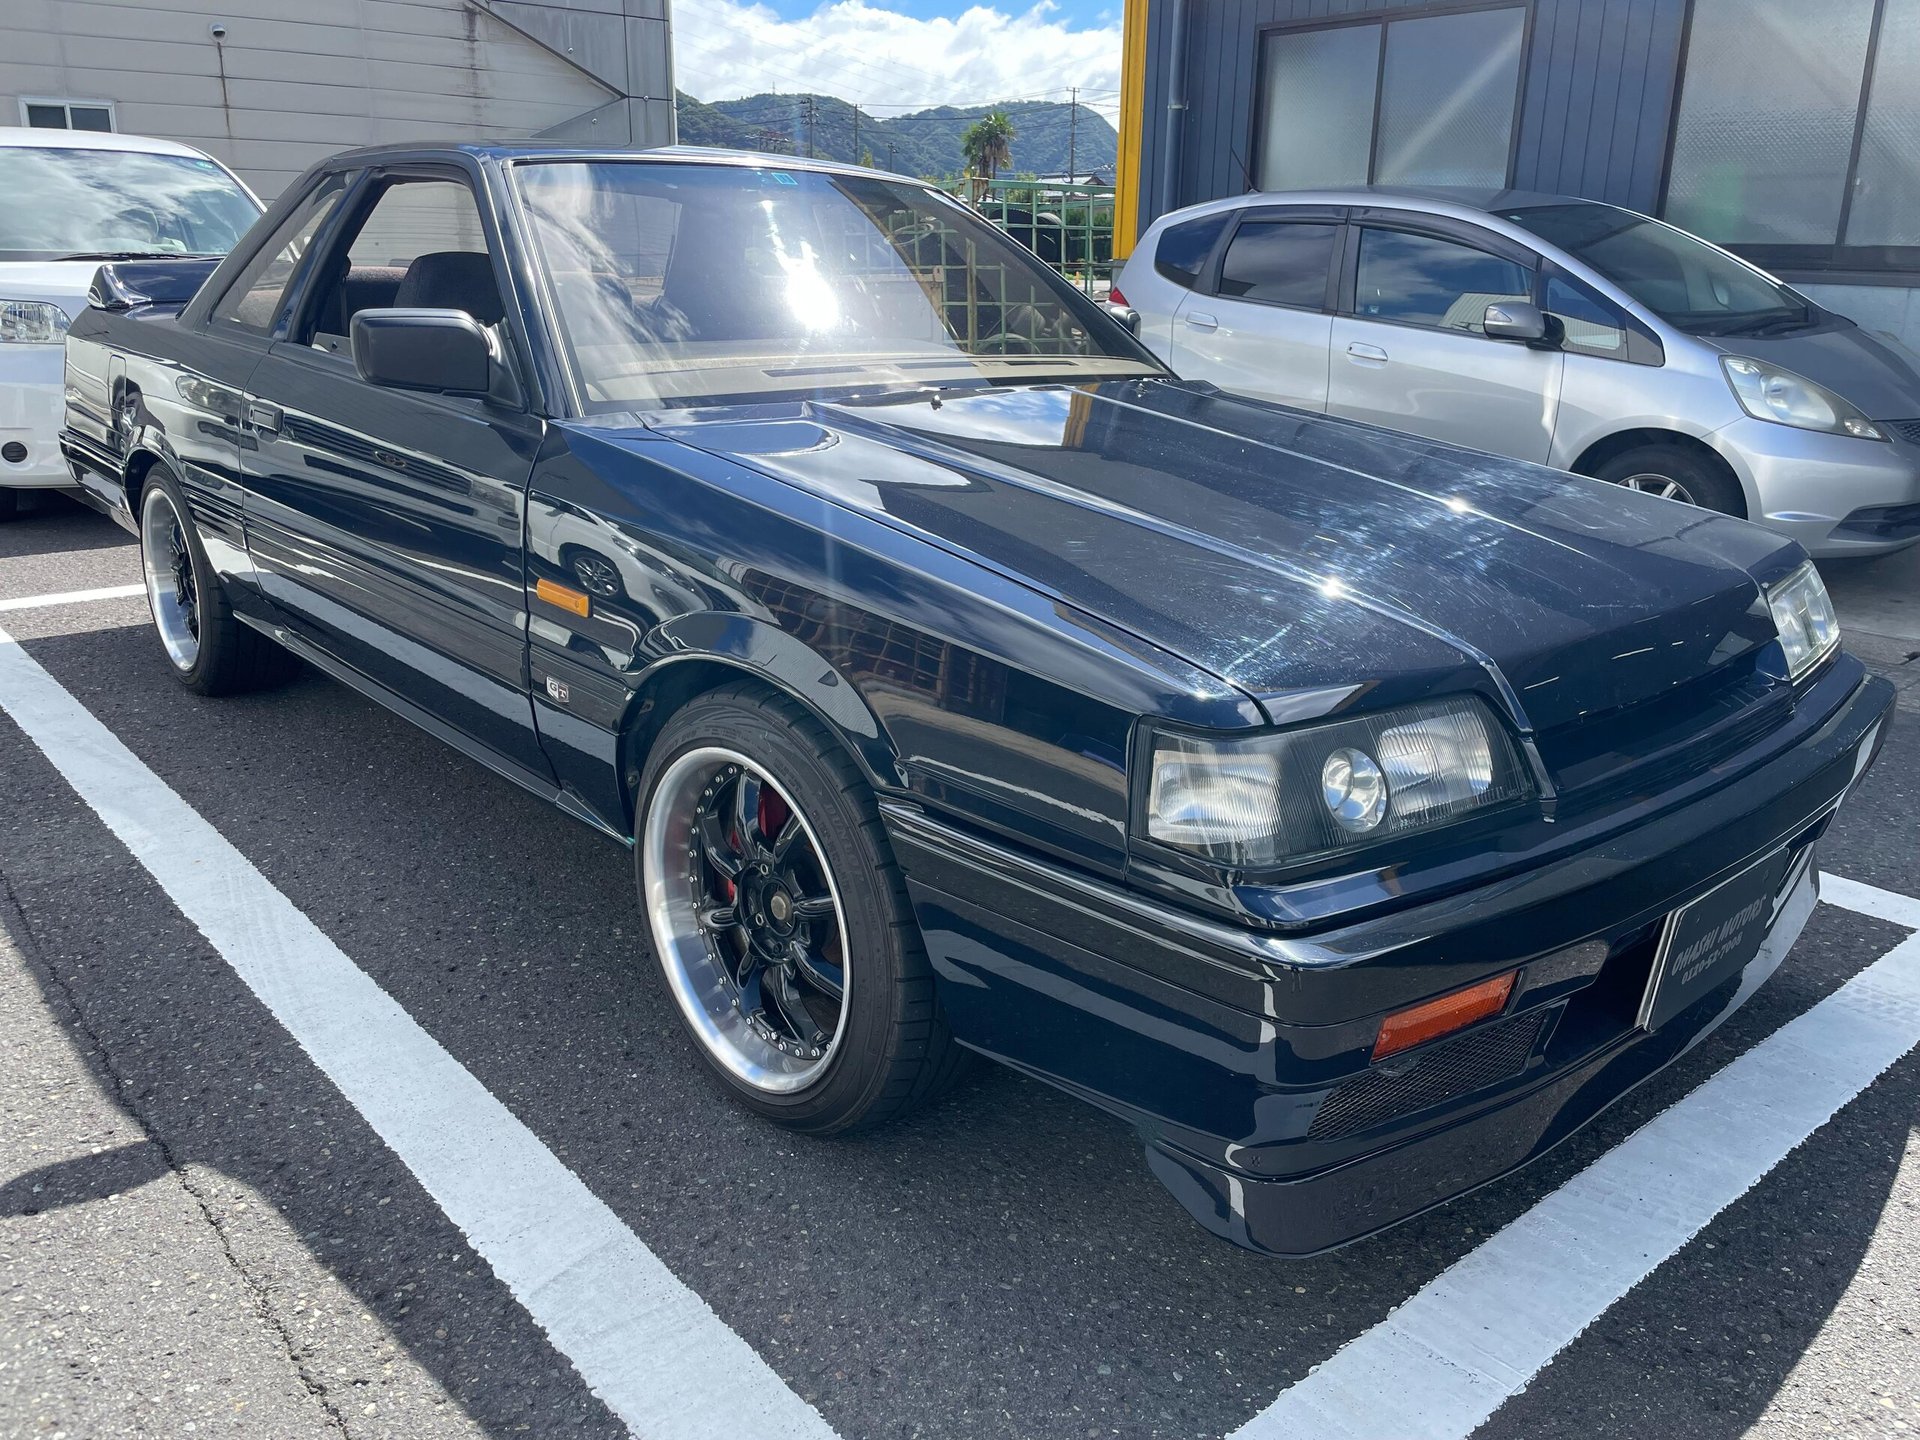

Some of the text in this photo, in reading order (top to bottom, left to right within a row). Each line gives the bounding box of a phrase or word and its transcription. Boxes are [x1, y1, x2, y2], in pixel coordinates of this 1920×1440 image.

[549, 680, 568, 700] GT
[823, 801, 866, 883] DUNLOP
[1671, 894, 1767, 976] OHASHI MOTORS
